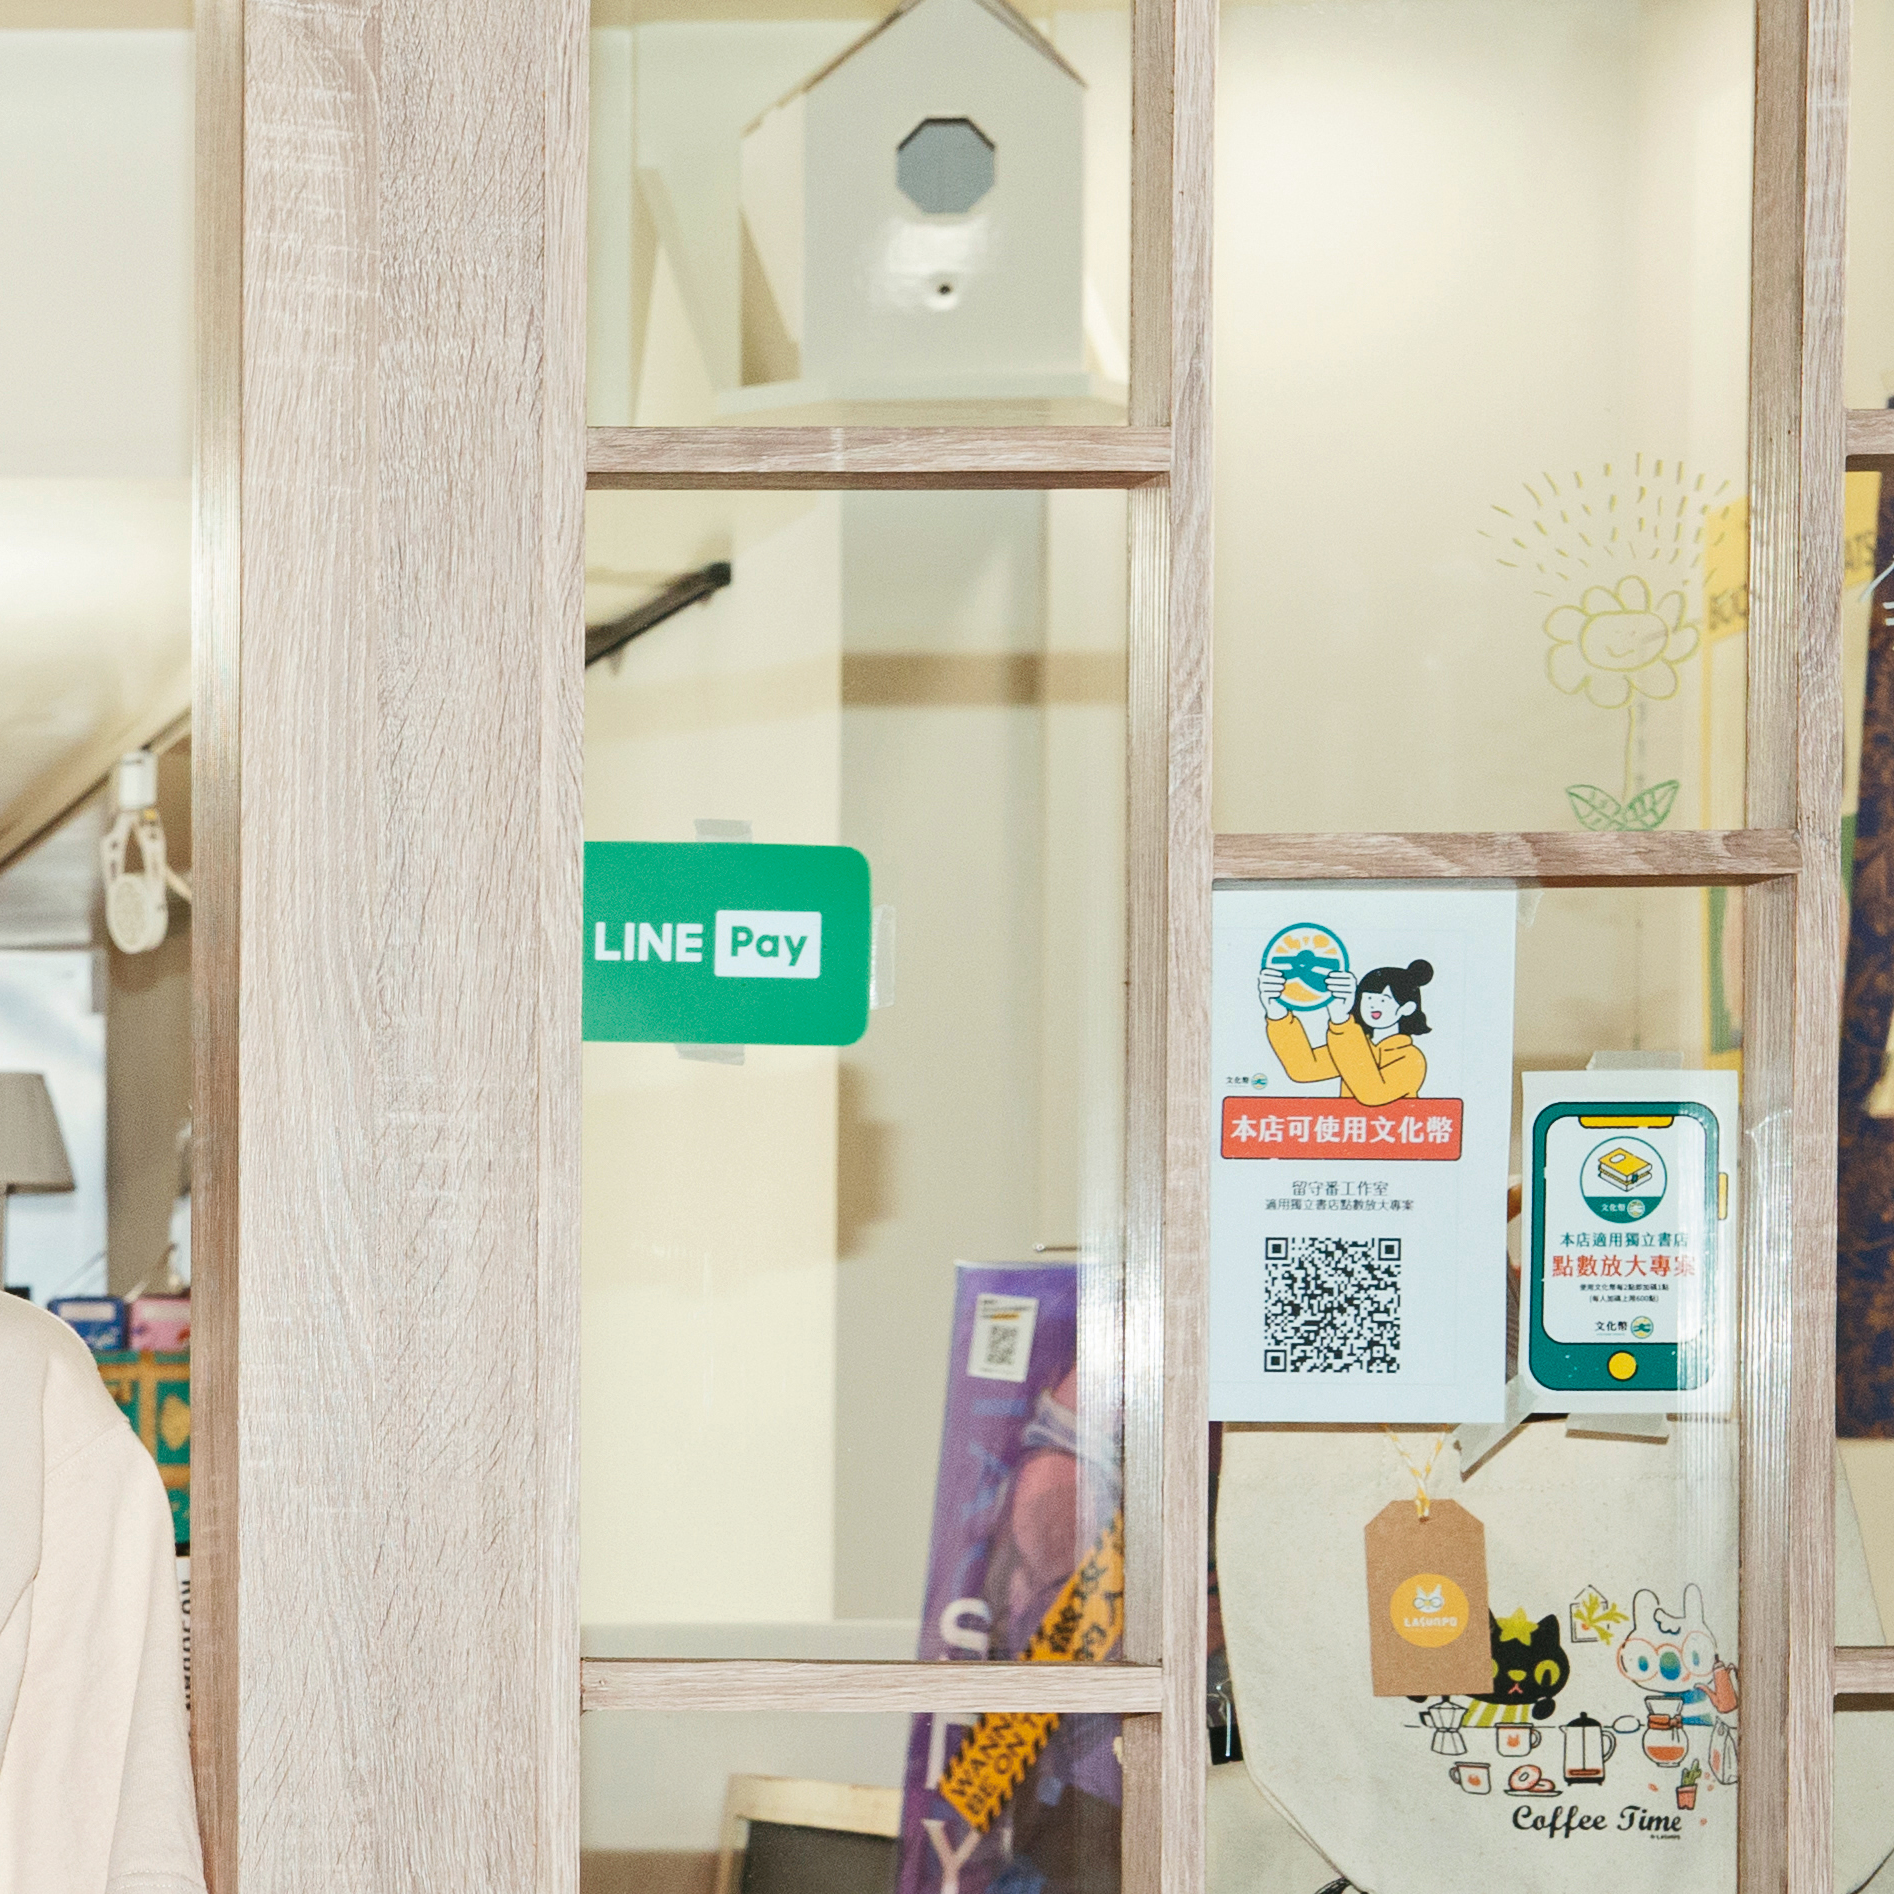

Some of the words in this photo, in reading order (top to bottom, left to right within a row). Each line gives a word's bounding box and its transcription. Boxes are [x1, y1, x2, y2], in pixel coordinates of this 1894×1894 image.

[595, 921, 704, 962] LINE
[730, 926, 808, 966] Pay
[1230, 1115, 1453, 1144] 本店可使用文化幣
[1292, 1180, 1389, 1197] 留守番工作室
[1265, 1198, 1414, 1211] 適用獨立書店點數放大專案
[1560, 1231, 1688, 1248] 本店適用獨立書店
[1552, 1254, 1695, 1277] 點數放大專案
[1594, 1321, 1628, 1332] 文化幣
[1512, 1804, 1608, 1839] Coffee
[1617, 1805, 1682, 1832] Time
